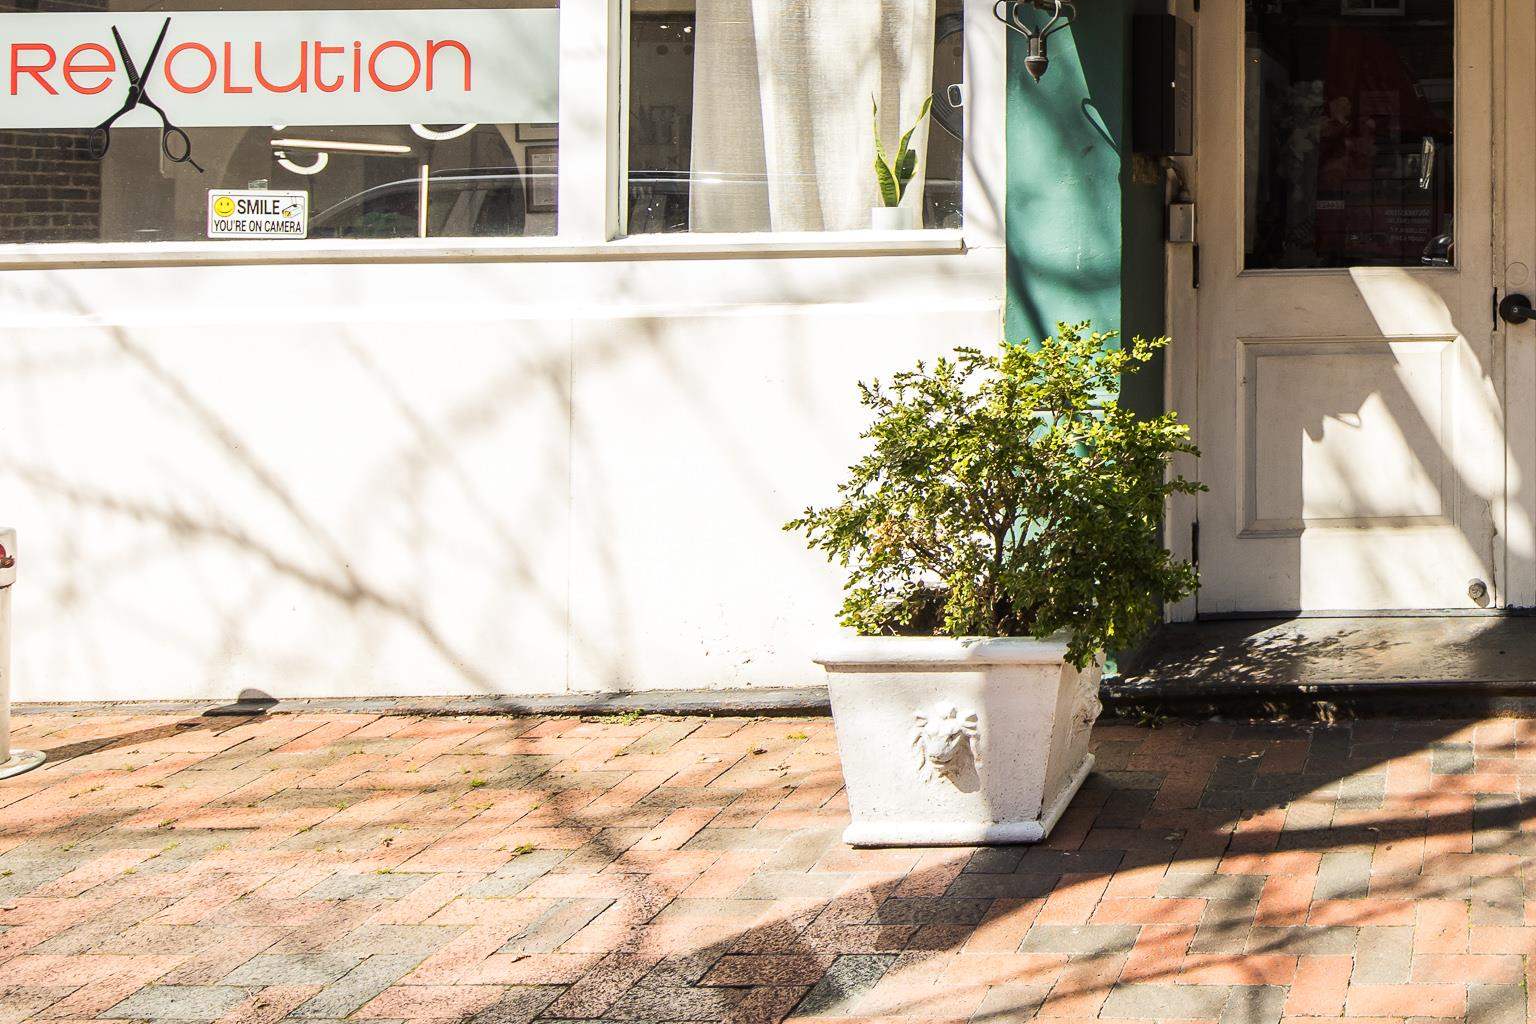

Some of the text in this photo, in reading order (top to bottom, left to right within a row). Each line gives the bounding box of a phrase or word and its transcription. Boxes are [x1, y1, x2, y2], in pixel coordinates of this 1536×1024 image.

[237, 199, 280, 215] SMILE
[213, 219, 302, 233] YOU'RE ON CAMERA
